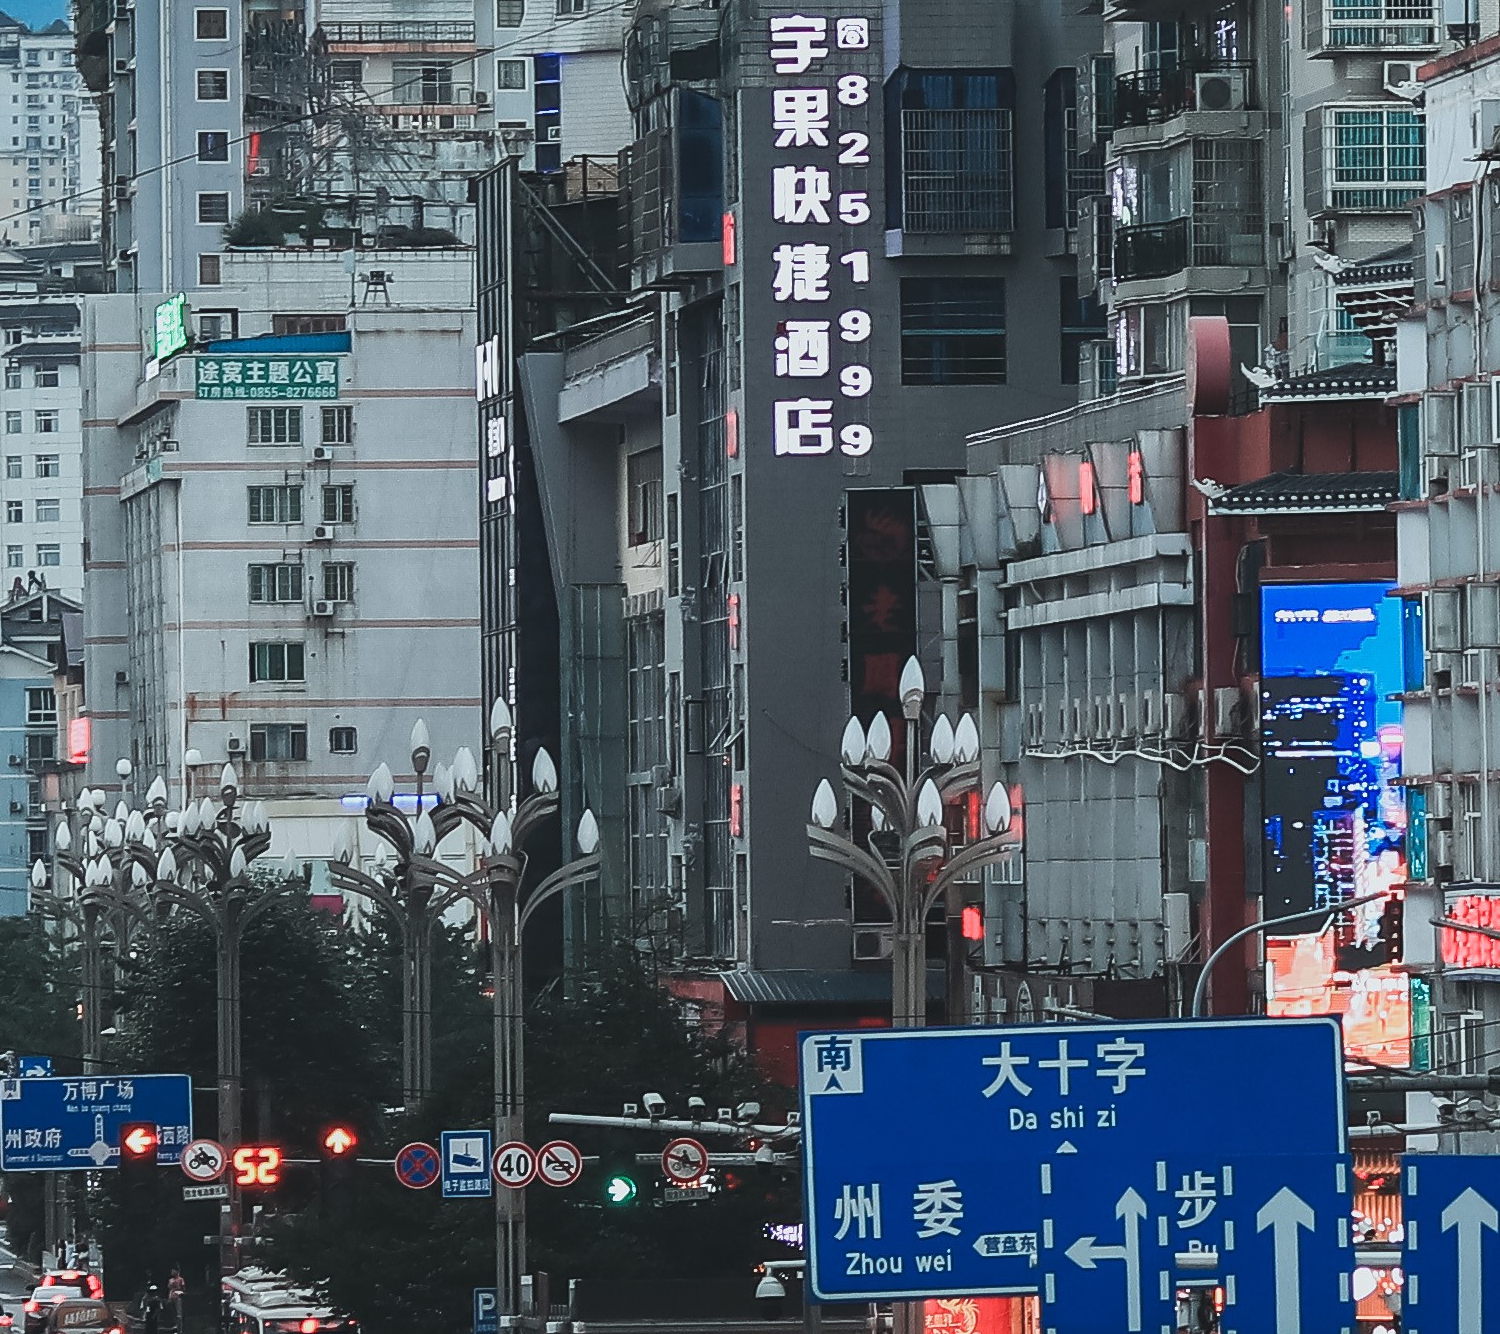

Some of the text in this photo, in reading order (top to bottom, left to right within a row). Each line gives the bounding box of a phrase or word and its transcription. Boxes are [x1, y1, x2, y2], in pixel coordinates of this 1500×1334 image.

[769, 15, 834, 457] 宇果快捷酒店
[836, 74, 873, 457] 8251999
[198, 361, 337, 384] 途窝主题公寓
[816, 1036, 853, 1072] 南
[981, 1037, 1146, 1098] 大十字
[62, 1080, 135, 1101] 万博广场
[1009, 1103, 1118, 1131] Da shi zi
[4, 1127, 63, 1149] 州政府
[233, 1147, 281, 1186] 52
[500, 1153, 529, 1178] 40
[1174, 1170, 1218, 1229] 步
[845, 1249, 953, 1275] Zhou wei
[478, 1292, 497, 1320] P
